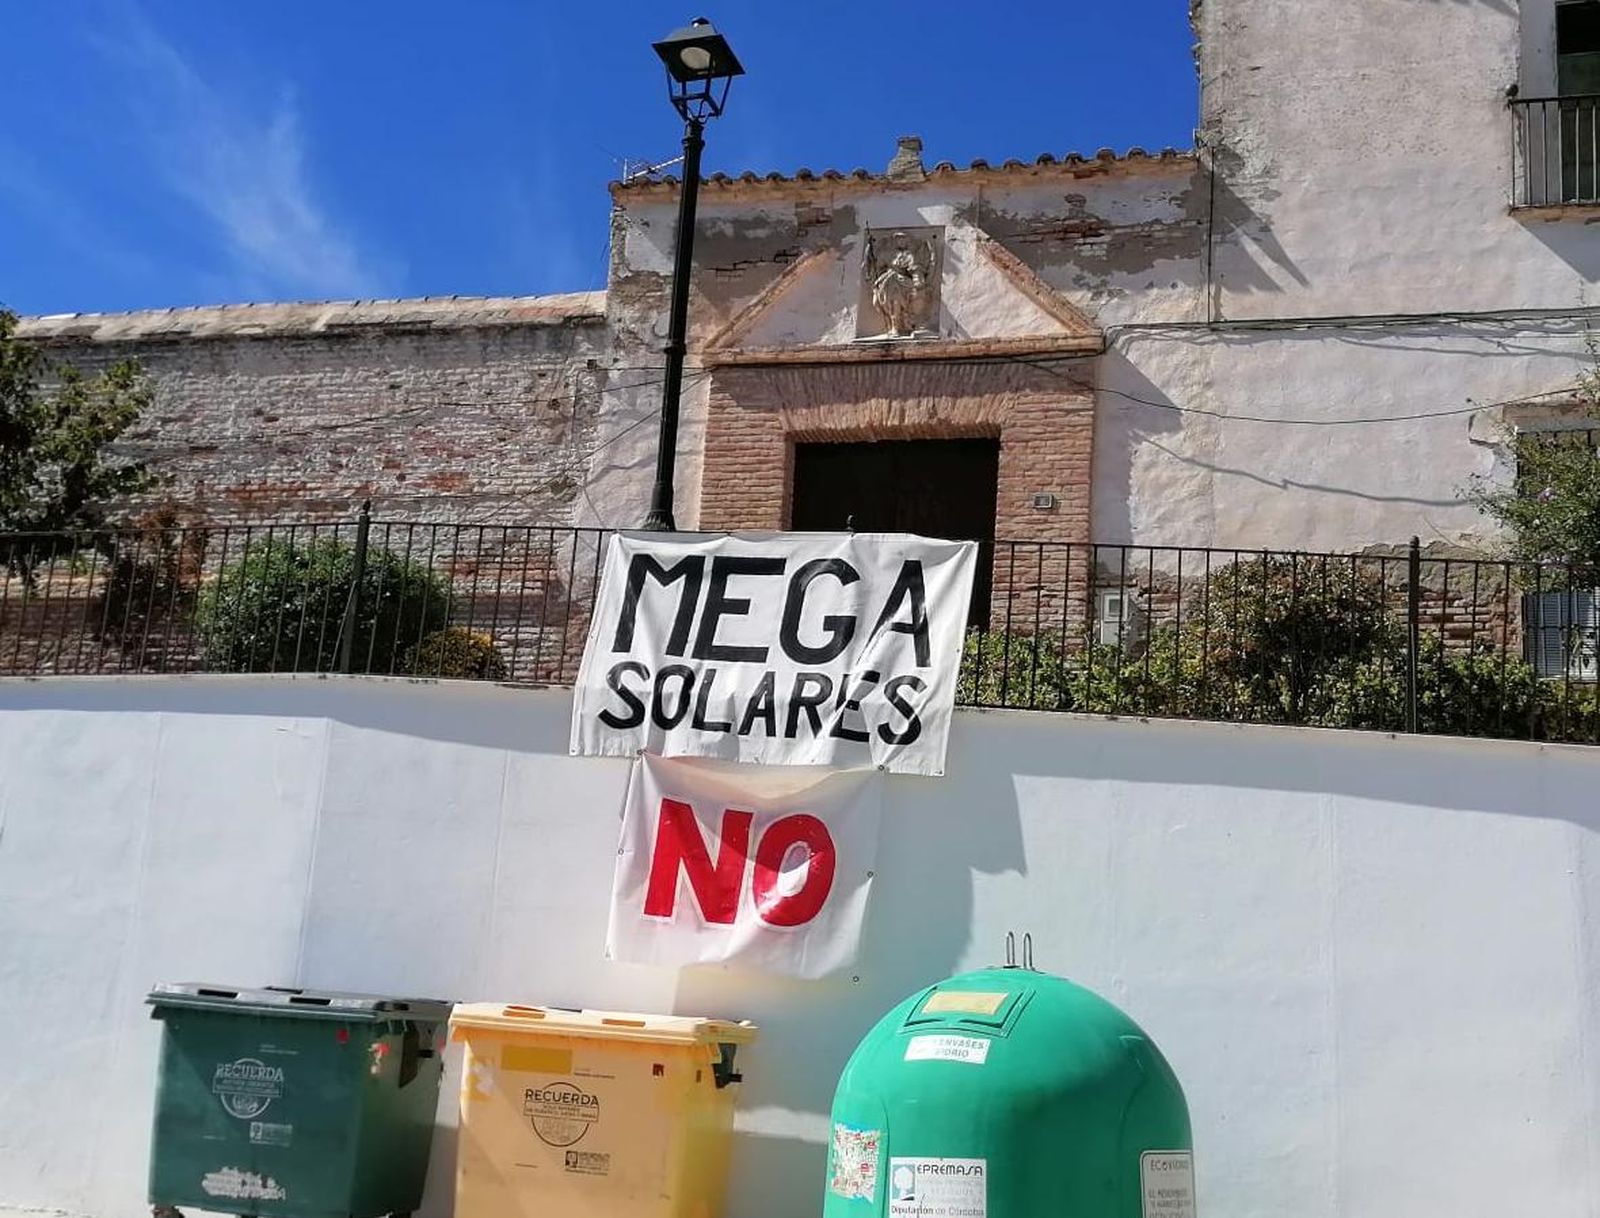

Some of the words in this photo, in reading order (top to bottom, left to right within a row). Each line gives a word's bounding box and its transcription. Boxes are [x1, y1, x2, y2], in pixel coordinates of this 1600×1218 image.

[611, 553, 932, 668] MEGA
[599, 660, 928, 746] SOLARES
[643, 797, 837, 927] NO
[216, 1064, 284, 1082] RECUERDA
[525, 1088, 599, 1106] RECUERDA
[916, 1164, 984, 1177] EPREMASA
